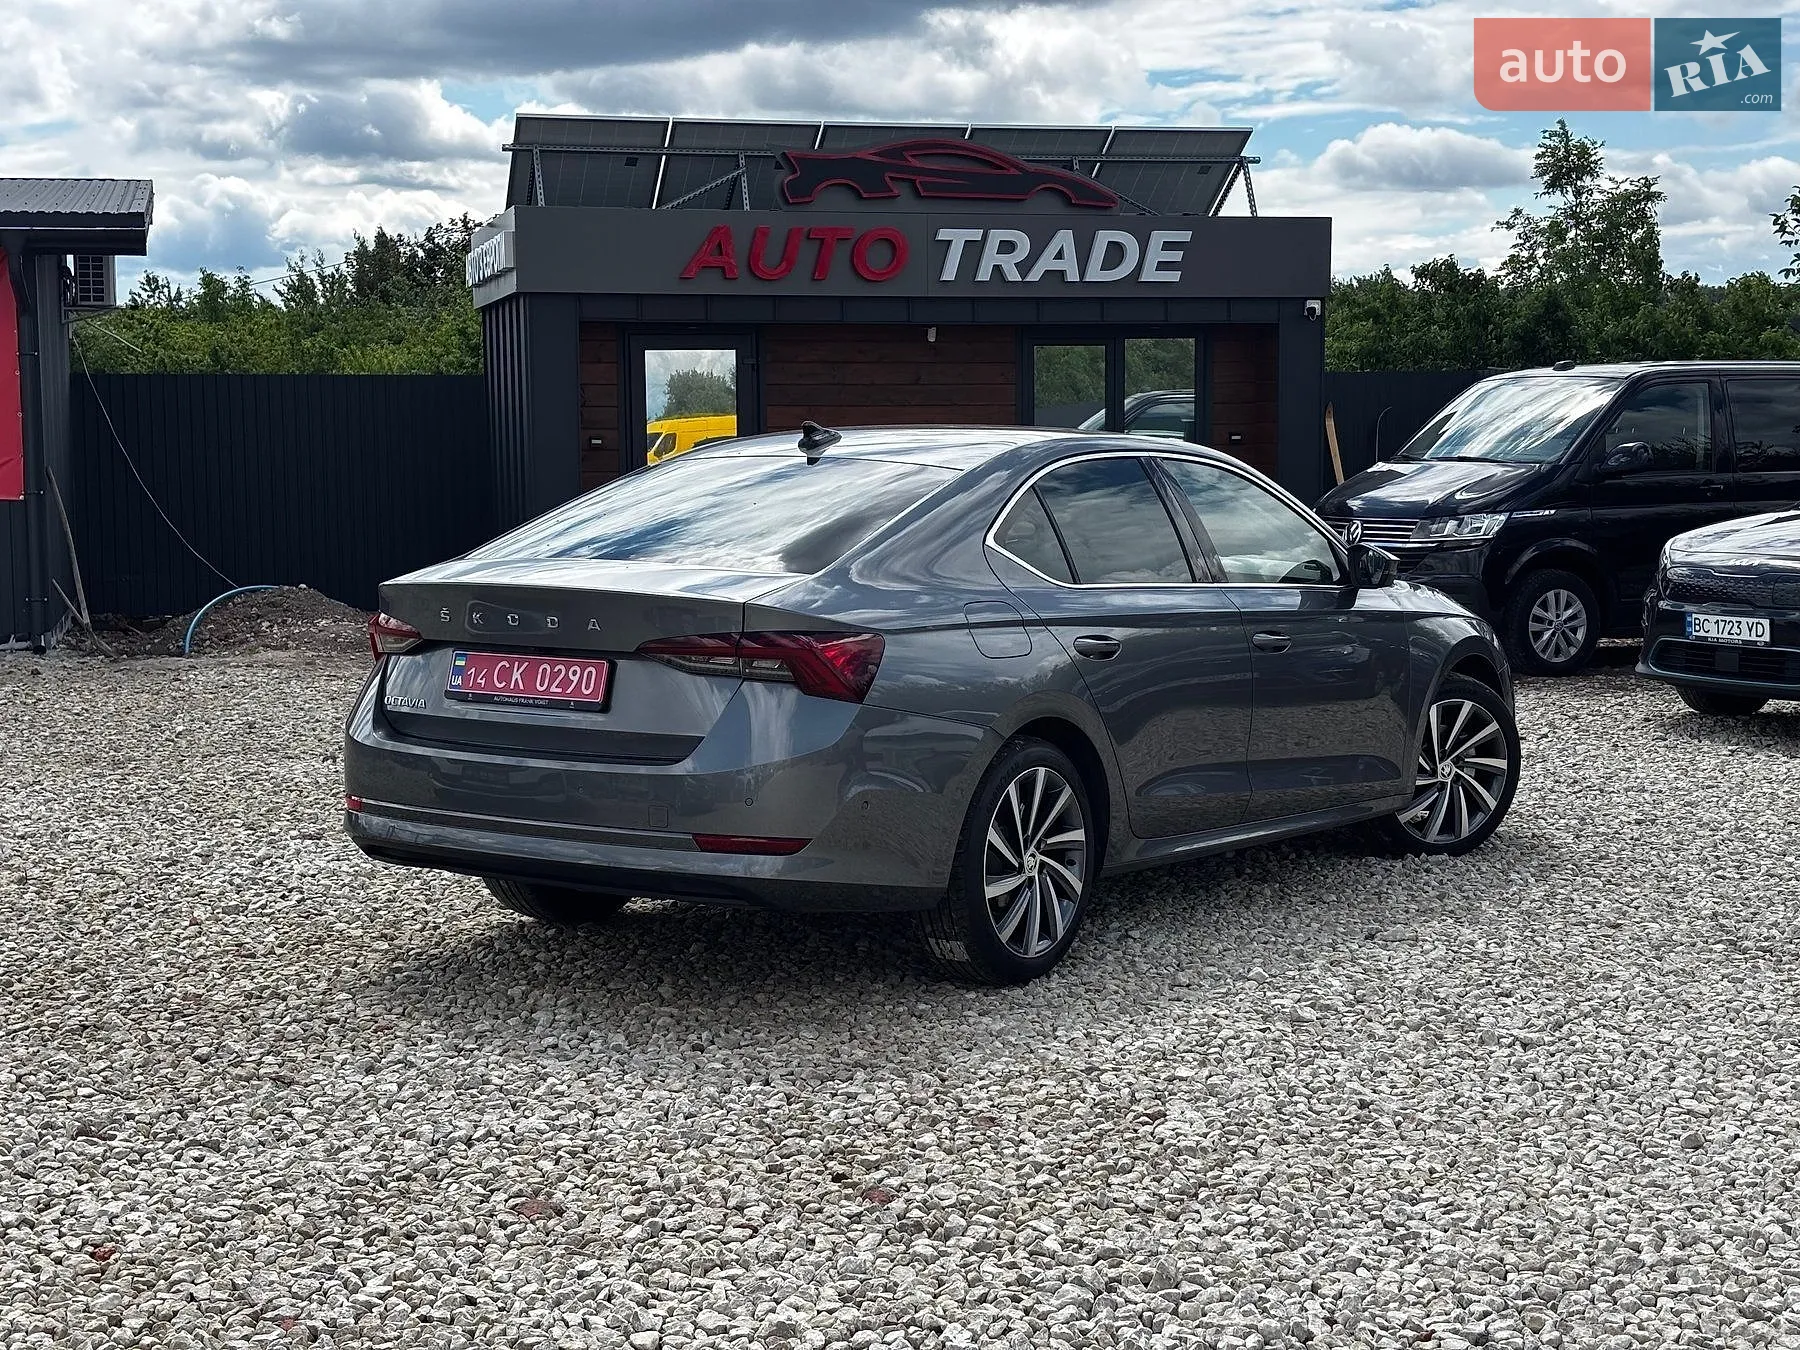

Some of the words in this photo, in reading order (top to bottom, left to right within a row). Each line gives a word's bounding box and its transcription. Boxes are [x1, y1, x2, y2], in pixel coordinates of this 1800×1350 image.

[679, 224, 910, 282] AUTO
[934, 228, 1193, 283] TRADE
[1693, 617, 1710, 633] BC
[1714, 619, 1742, 636] 1723
[1746, 620, 1765, 638] YD
[451, 674, 463, 687] UA
[467, 667, 488, 689] 14
[493, 660, 529, 690] CK
[535, 663, 597, 695] 0290
[384, 695, 427, 709] OCTAVIA
